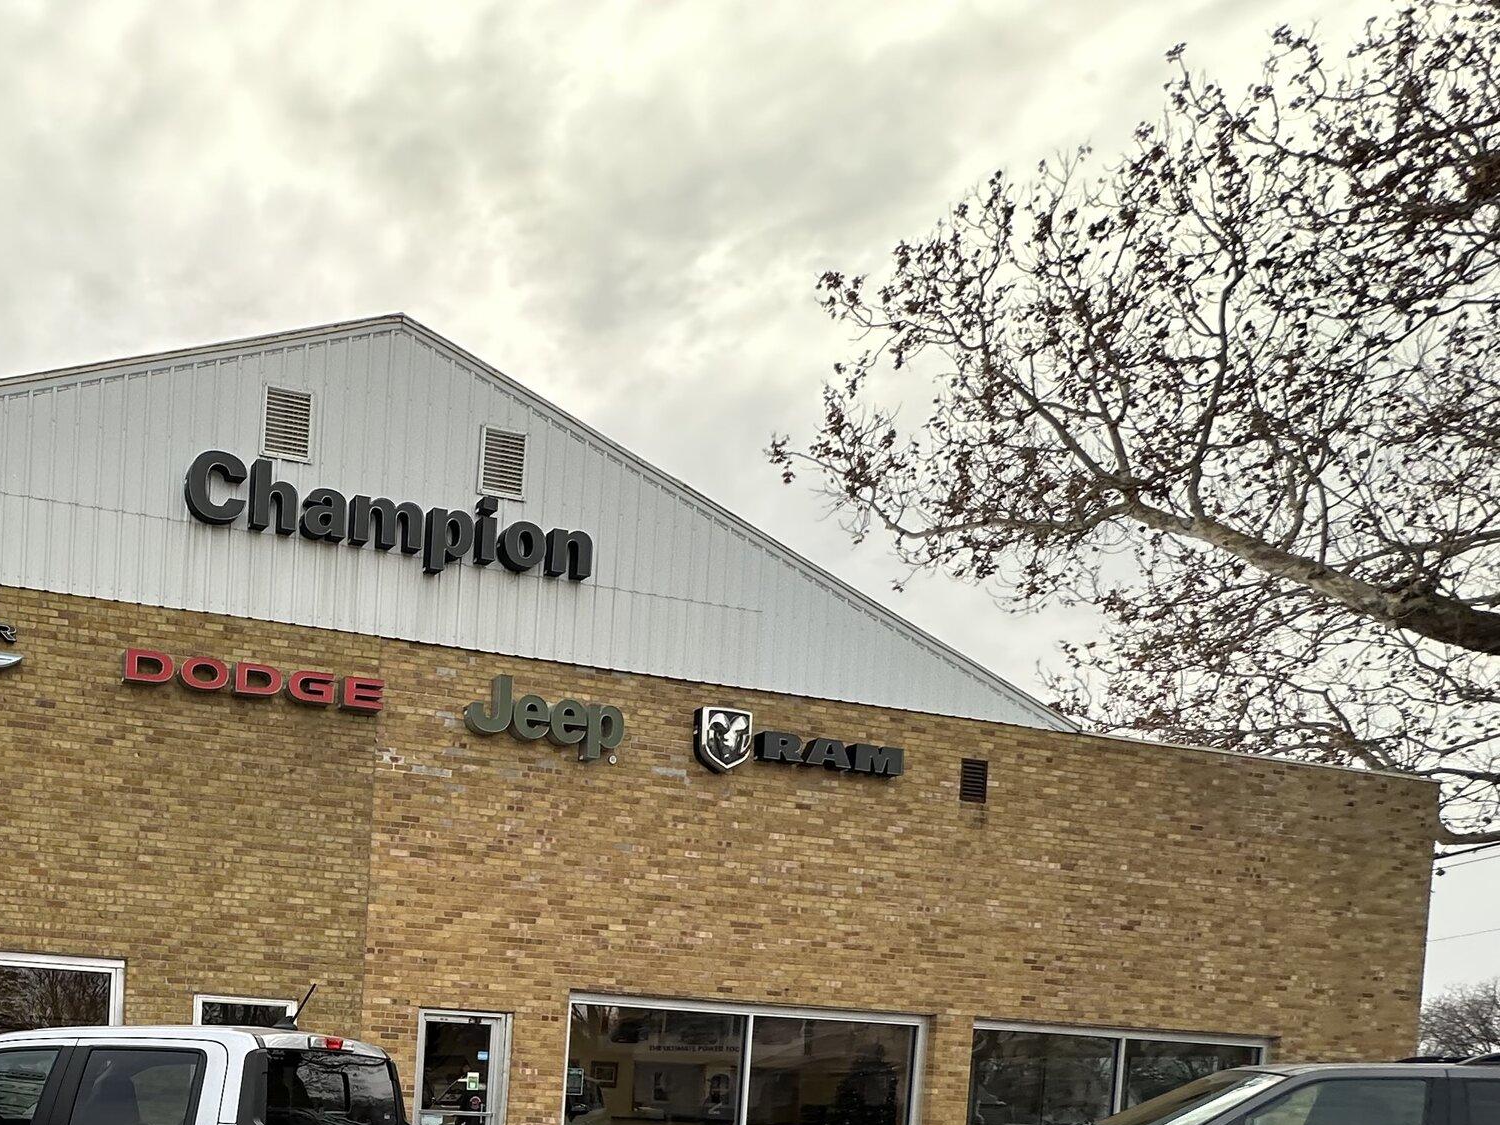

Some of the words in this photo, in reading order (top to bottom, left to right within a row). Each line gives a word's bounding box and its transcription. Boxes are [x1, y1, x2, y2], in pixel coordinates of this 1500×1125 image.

[184, 449, 594, 581] Champion
[121, 647, 385, 715] DODGE
[463, 674, 625, 762] Jeep
[753, 731, 905, 777] RAM
